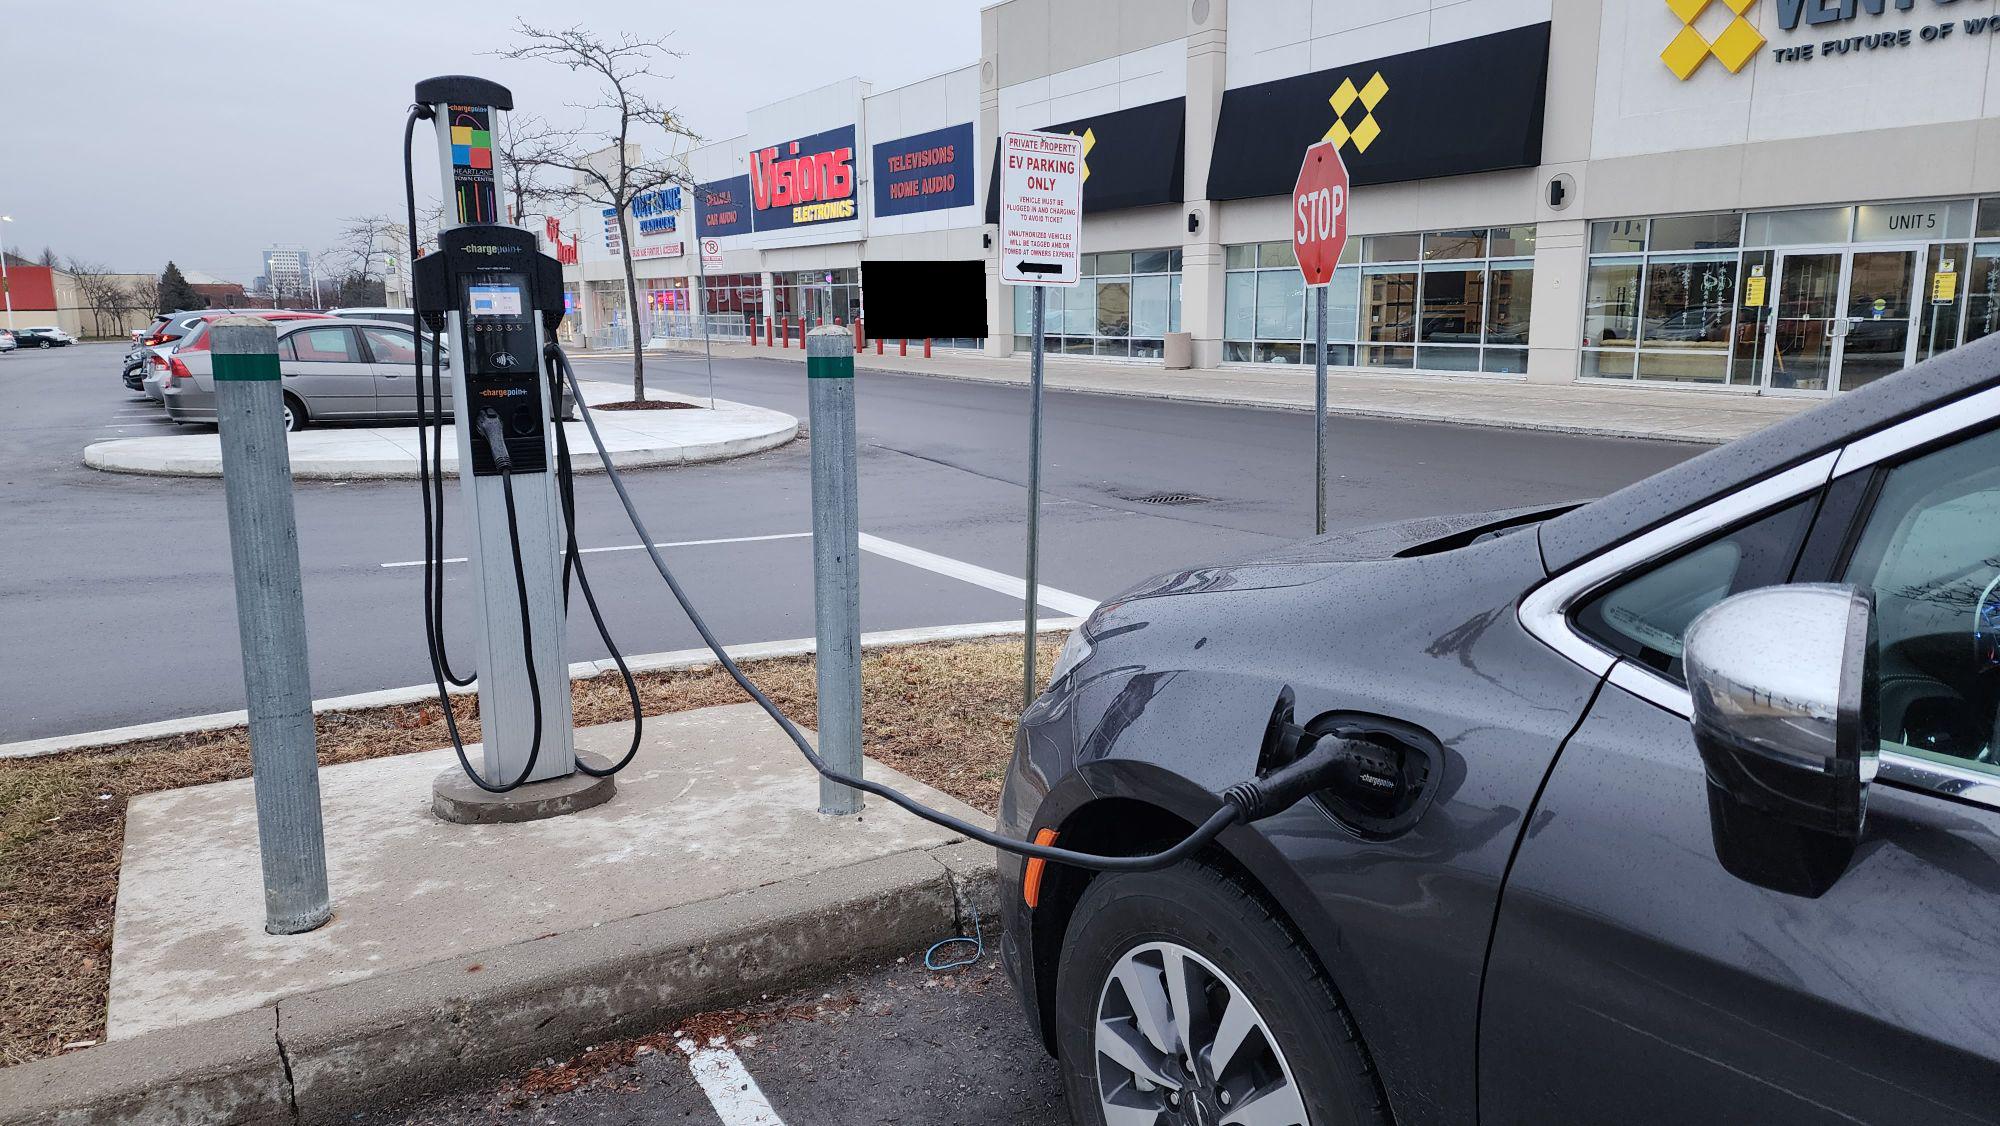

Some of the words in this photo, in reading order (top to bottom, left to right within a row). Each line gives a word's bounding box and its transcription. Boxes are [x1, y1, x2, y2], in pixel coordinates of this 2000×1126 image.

[1773, 44, 1814, 63] THE
[1821, 29, 1911, 57] FUTURE
[1919, 22, 1955, 42] OF
[1009, 138, 1039, 149] PRIVATE
[1040, 141, 1077, 153] PROPERTY
[888, 145, 955, 173] TELEVISIONS
[1009, 156, 1024, 168] EV
[1026, 157, 1075, 175] PARKING
[890, 179, 920, 199] HOME
[922, 173, 955, 195] AUDIO
[1027, 176, 1056, 191] ONLY
[1006, 204, 1030, 212] PLUGGED
[1050, 208, 1076, 216] CHARGING
[1042, 198, 1056, 206] MUST
[706, 213, 718, 226] CAR
[719, 211, 737, 224] AUDIO
[793, 200, 854, 223] ELECTRONICS
[1297, 185, 1344, 245] STOP
[1889, 214, 1923, 230] UNIT
[1926, 213, 1936, 229] 5
[1008, 230, 1047, 239] UNAUTHORIZED
